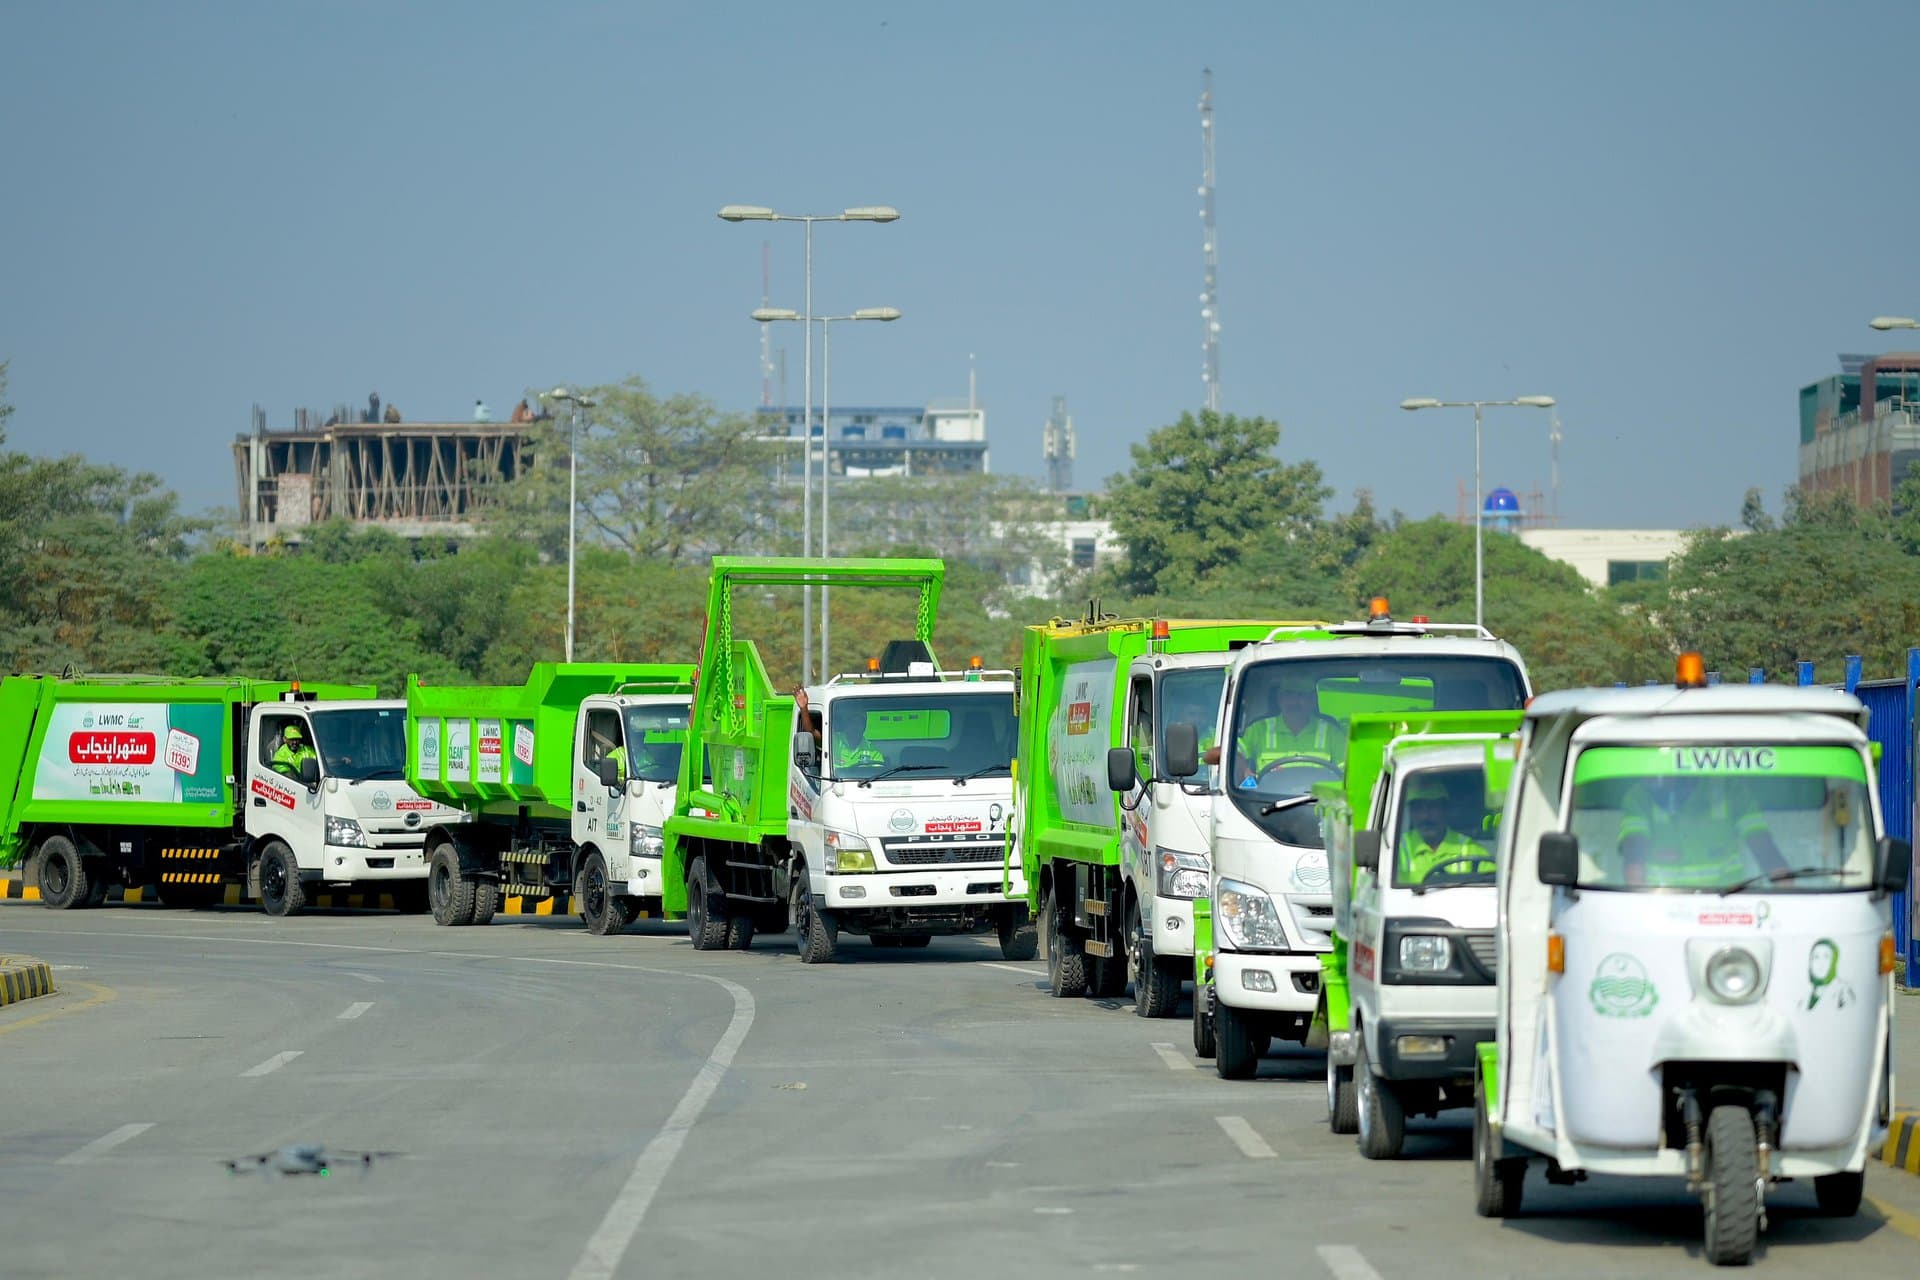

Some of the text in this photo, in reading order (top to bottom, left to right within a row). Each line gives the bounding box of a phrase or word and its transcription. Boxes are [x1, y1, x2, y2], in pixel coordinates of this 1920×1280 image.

[98, 714, 124, 726] LWMC
[483, 727, 499, 737] LWMC
[77, 736, 114, 763] پنجاب
[1676, 748, 1774, 770] LWMC
[908, 834, 990, 843] FUSO
